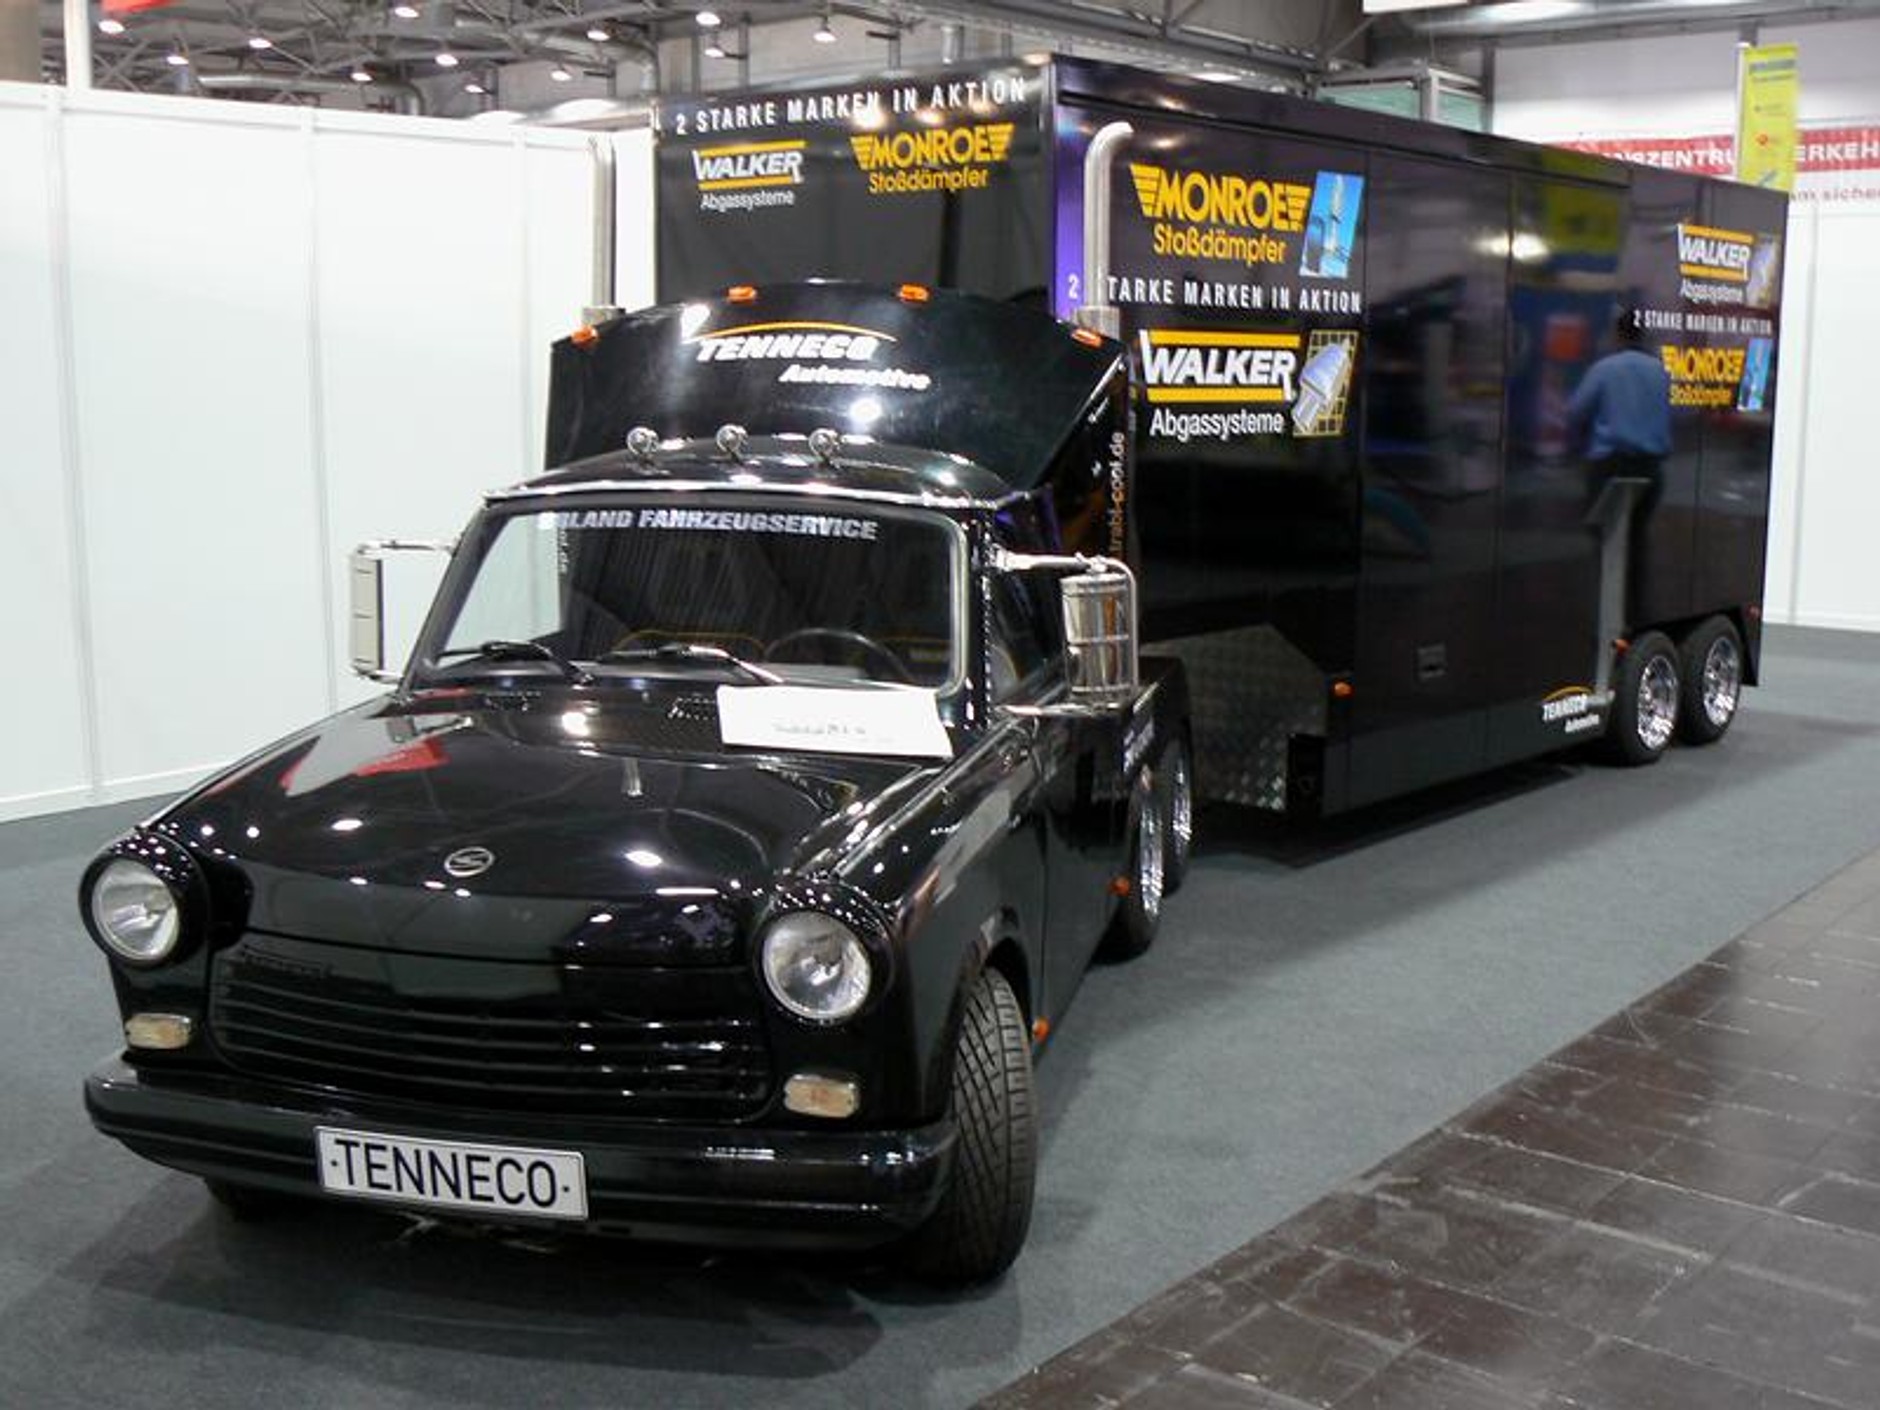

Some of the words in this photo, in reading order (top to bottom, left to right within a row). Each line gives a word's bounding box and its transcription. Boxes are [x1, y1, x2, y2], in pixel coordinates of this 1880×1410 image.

[676, 114, 686, 135] 2
[696, 101, 776, 133] STARKE
[787, 91, 880, 123] MARKEN
[892, 87, 917, 113] IN
[931, 77, 1026, 109] AKTION
[692, 149, 804, 184] WALKER
[868, 124, 992, 170] MONROE
[700, 189, 795, 213] Abgassysteme
[1153, 169, 1290, 231] MONROE
[1153, 223, 1287, 267] Stoßdämpfer
[1677, 223, 1751, 281] WALKER
[1068, 274, 1079, 299] 2
[1108, 276, 1174, 304] TARKE
[1184, 281, 1263, 308] MARKEN
[1271, 287, 1290, 309] IN
[1299, 290, 1362, 313] AKTION
[697, 333, 880, 361] TENNECO
[1139, 329, 1297, 401] WALKER
[1670, 346, 1740, 382] MONROE
[1149, 408, 1284, 442] Abgassysteme
[638, 509, 878, 540] FAHRZEUGSERVICE
[334, 1138, 556, 1208] TENNECO
